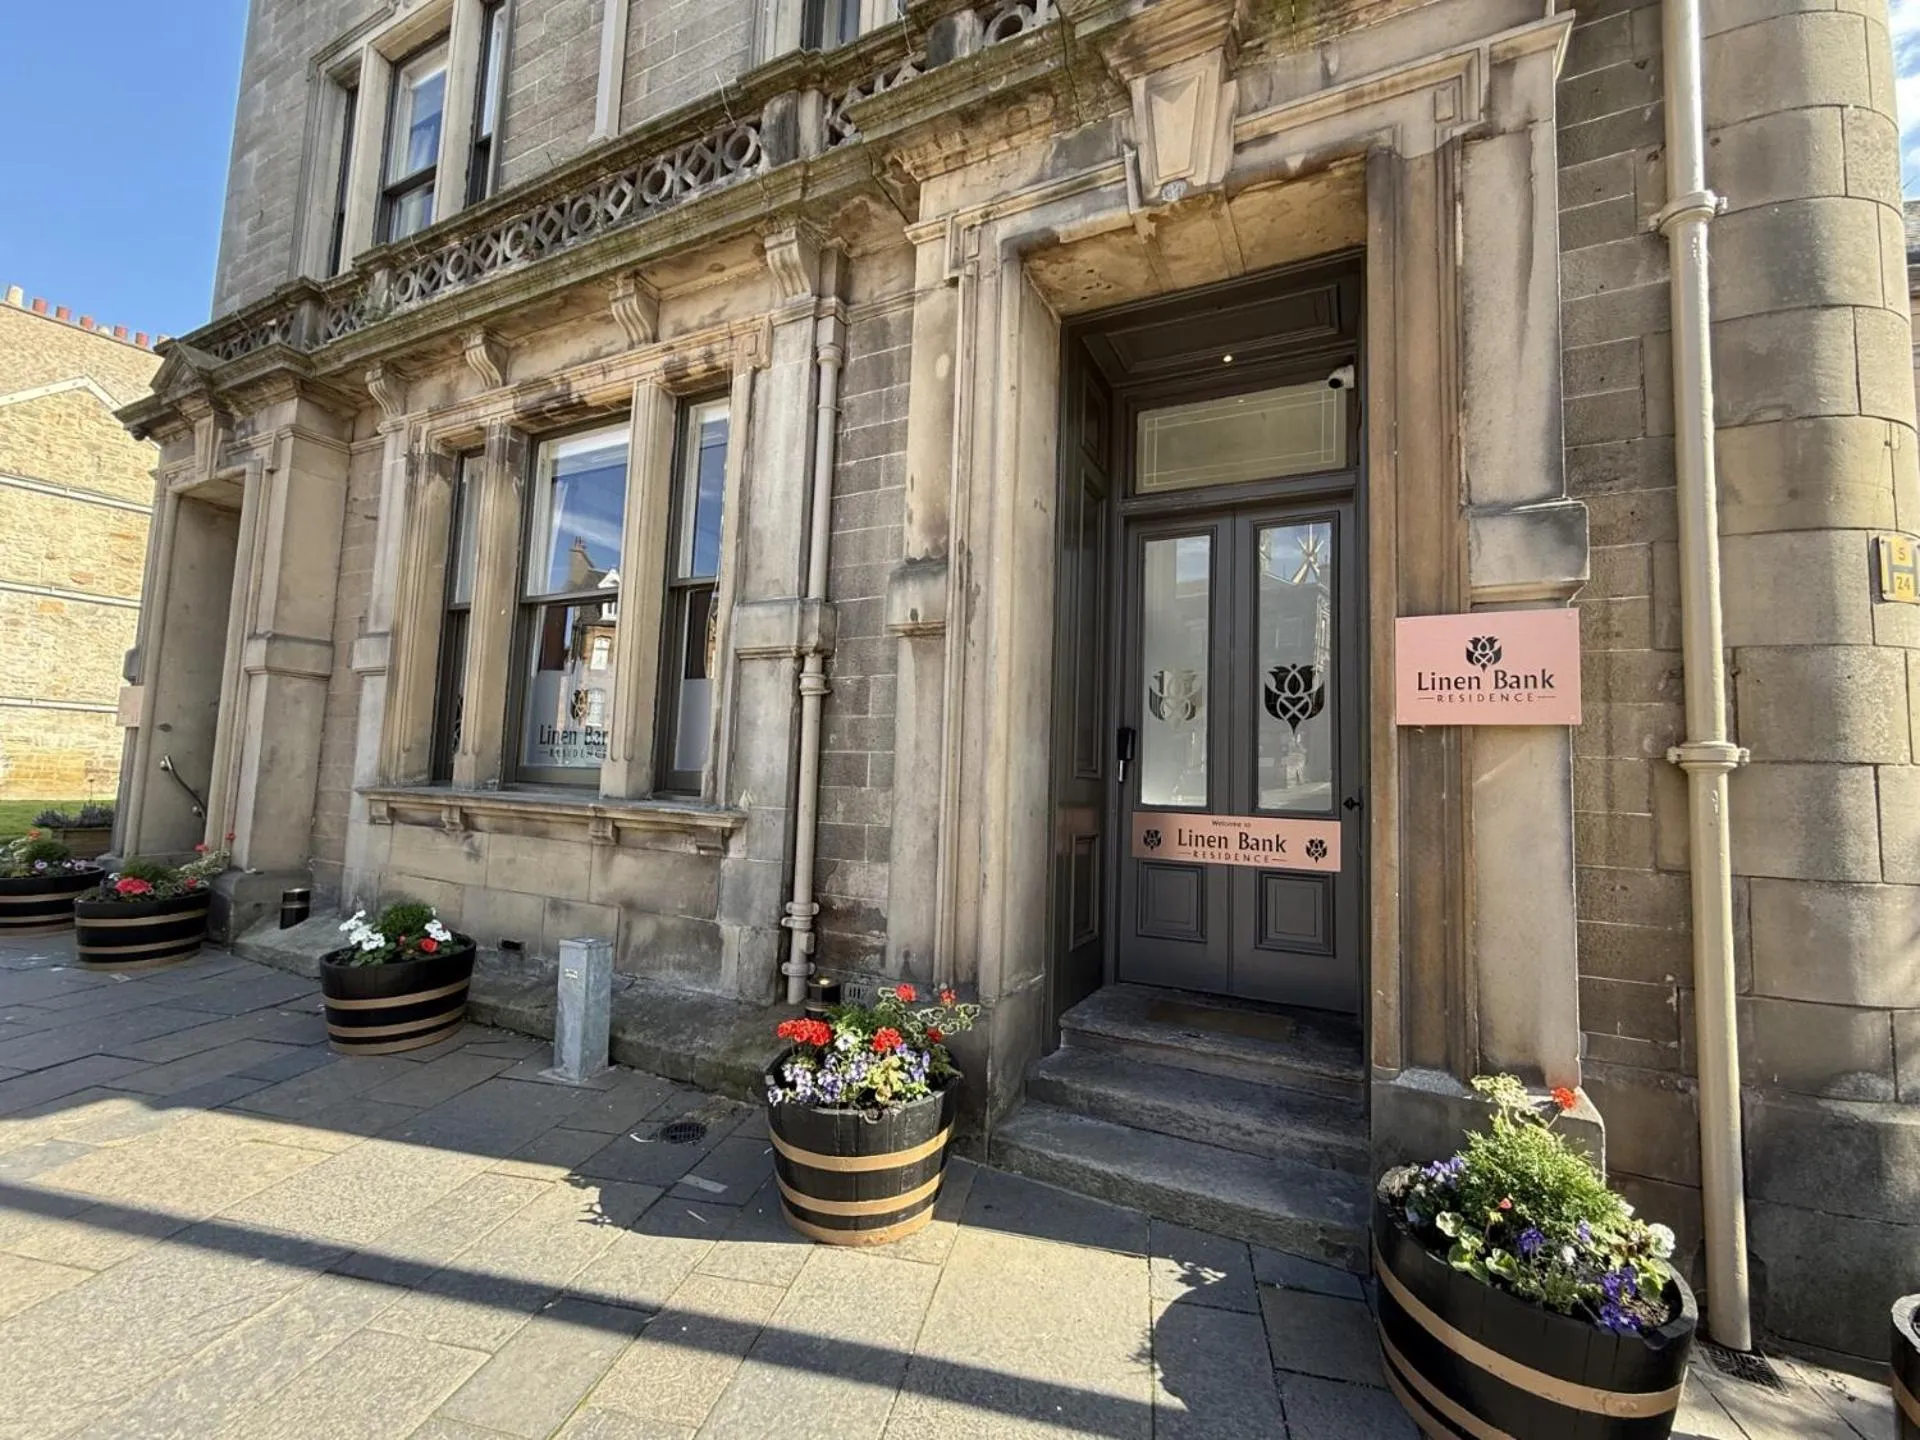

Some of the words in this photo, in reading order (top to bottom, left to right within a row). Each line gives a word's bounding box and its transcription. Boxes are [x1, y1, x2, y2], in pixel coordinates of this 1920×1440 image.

[1898, 547, 1907, 562] 5
[1896, 575, 1911, 591] 24
[1417, 672, 1481, 691] Linen
[1494, 668, 1555, 690] Bank
[1436, 692, 1534, 703] RESIDENCE
[539, 724, 577, 745] Linen
[584, 724, 609, 746] Ban
[1211, 819, 1241, 828] Welcome
[1177, 828, 1229, 849] Linen
[1238, 831, 1288, 853] Bank
[1193, 850, 1269, 863] RESIDENCE
